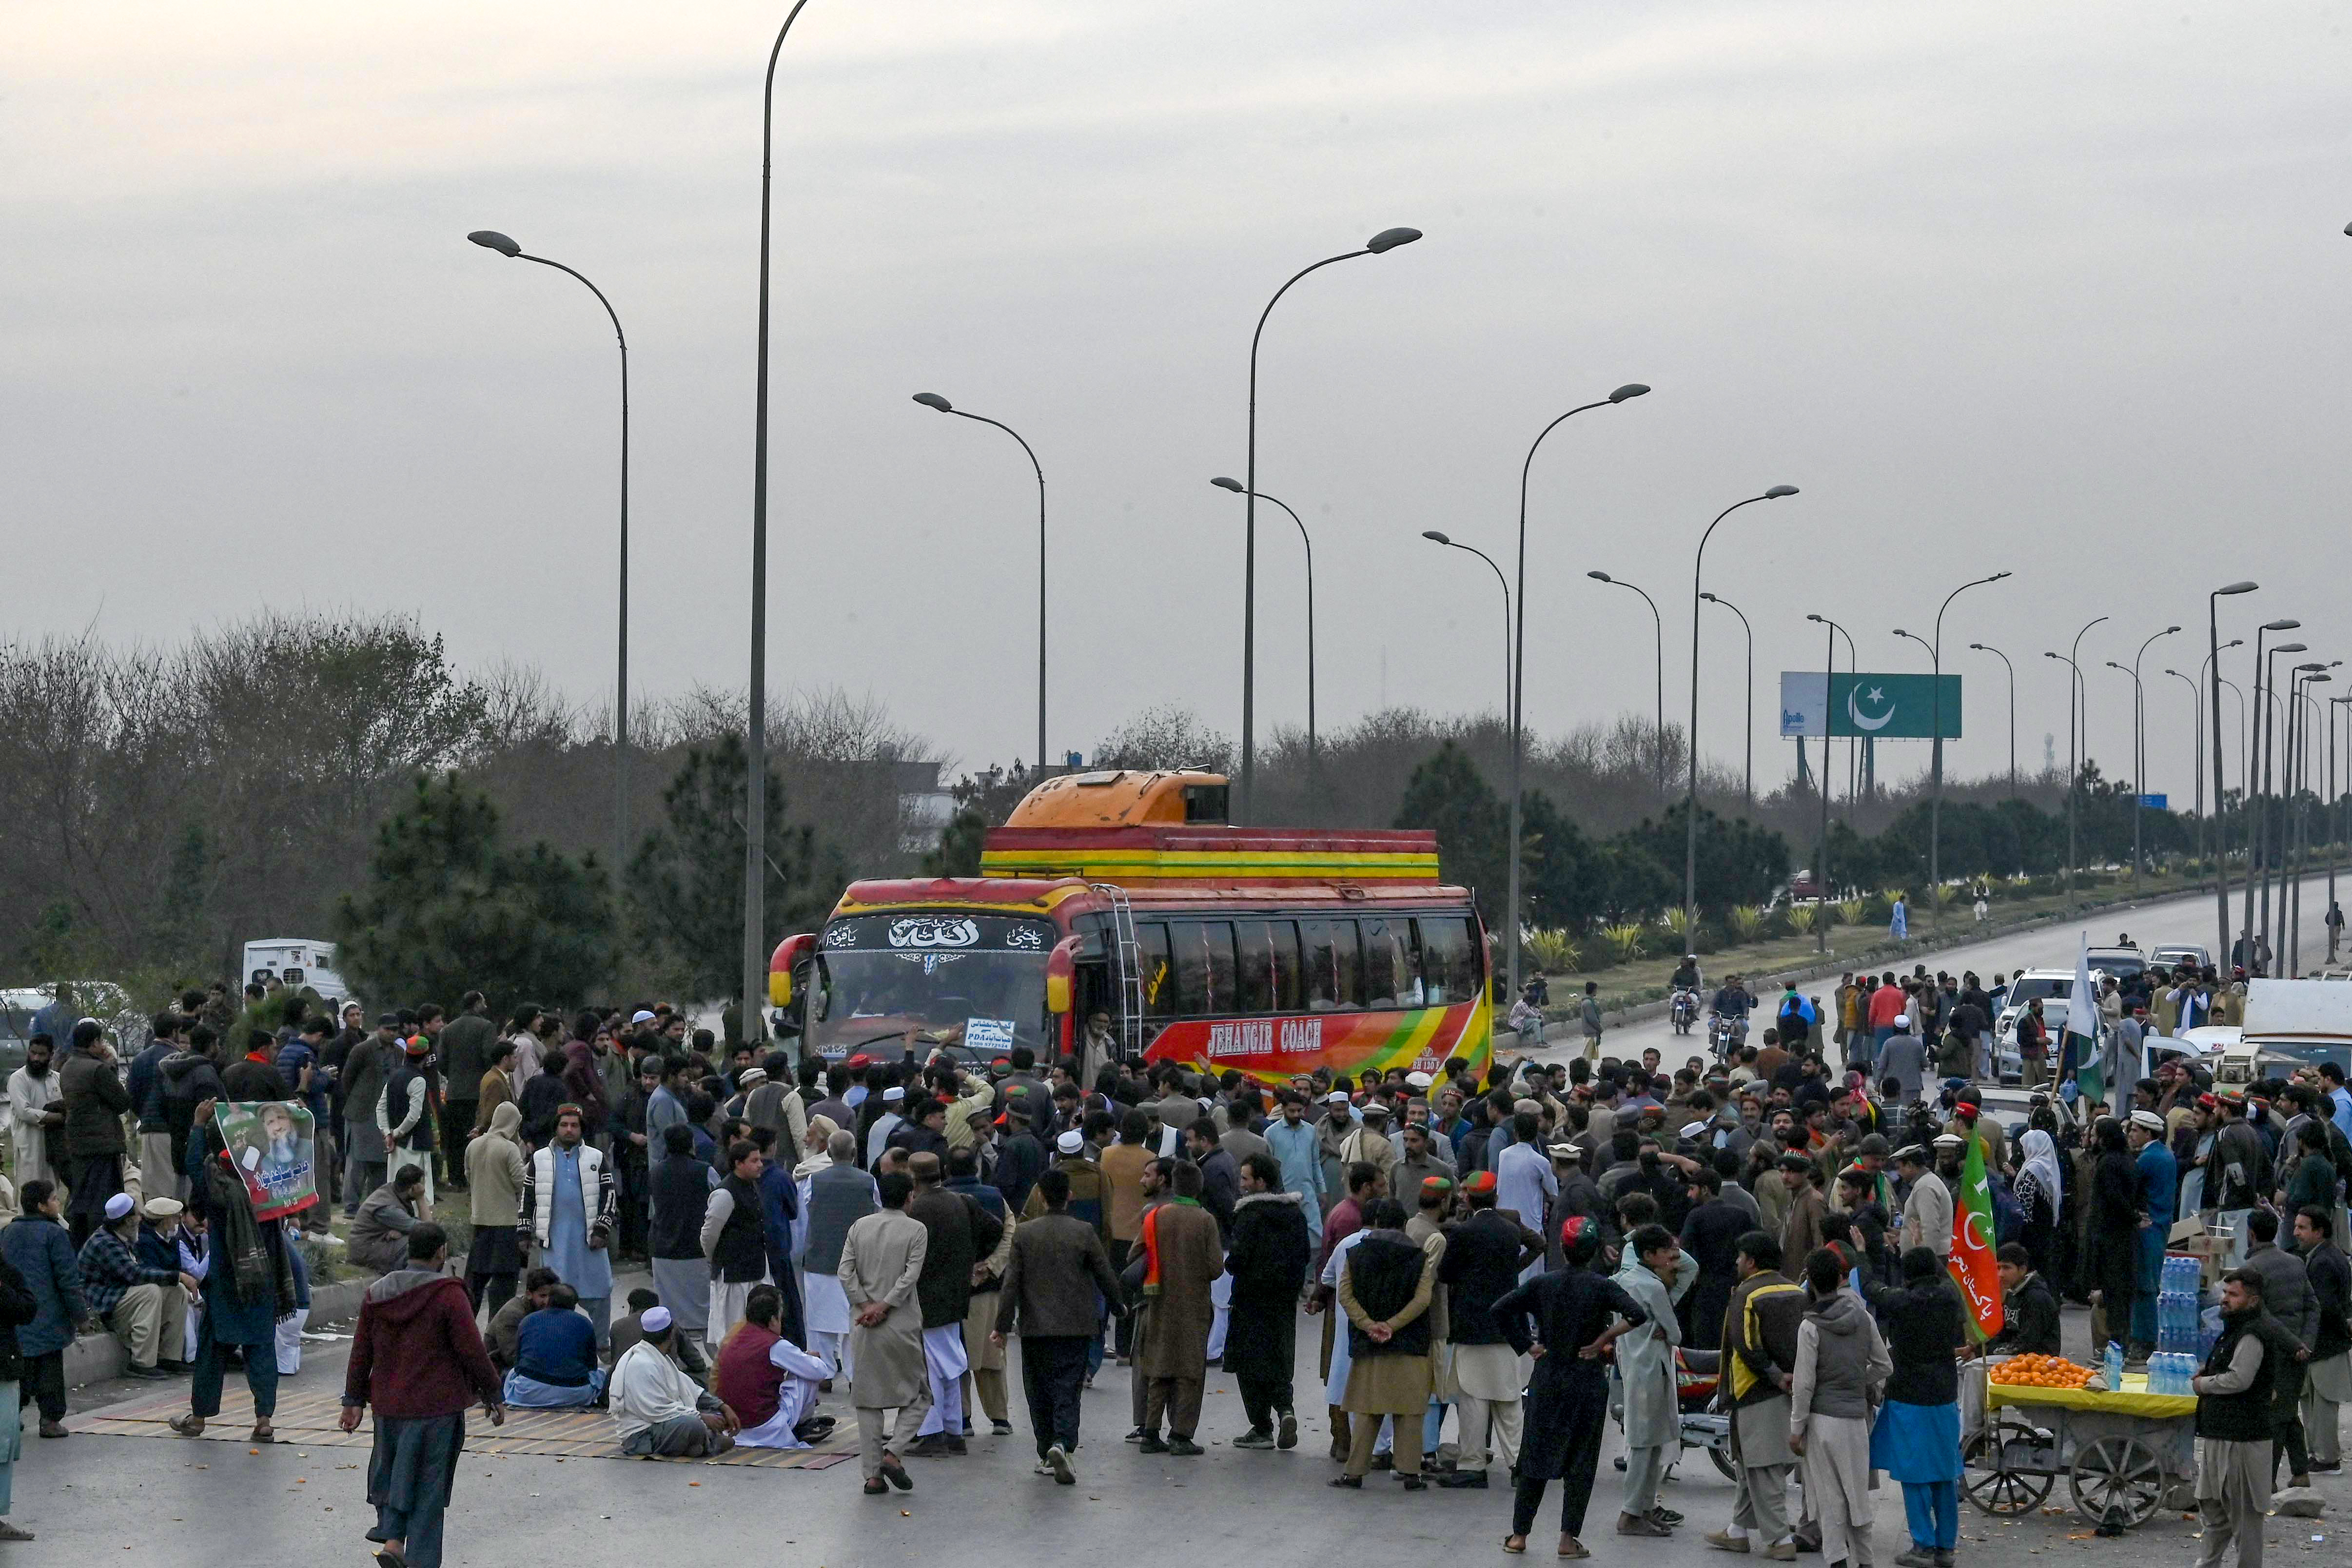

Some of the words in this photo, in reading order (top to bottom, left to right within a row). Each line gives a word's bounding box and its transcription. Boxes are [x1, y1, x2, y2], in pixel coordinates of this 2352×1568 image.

[1784, 709, 1804, 725] Apollo
[1208, 1022, 1273, 1057] JEHANGIR
[1280, 1019, 1322, 1052] COACH
[1412, 1061, 1422, 1069] BH
[1424, 1061, 1434, 1069] 120
[1963, 1274, 1993, 1320] پاکستان
